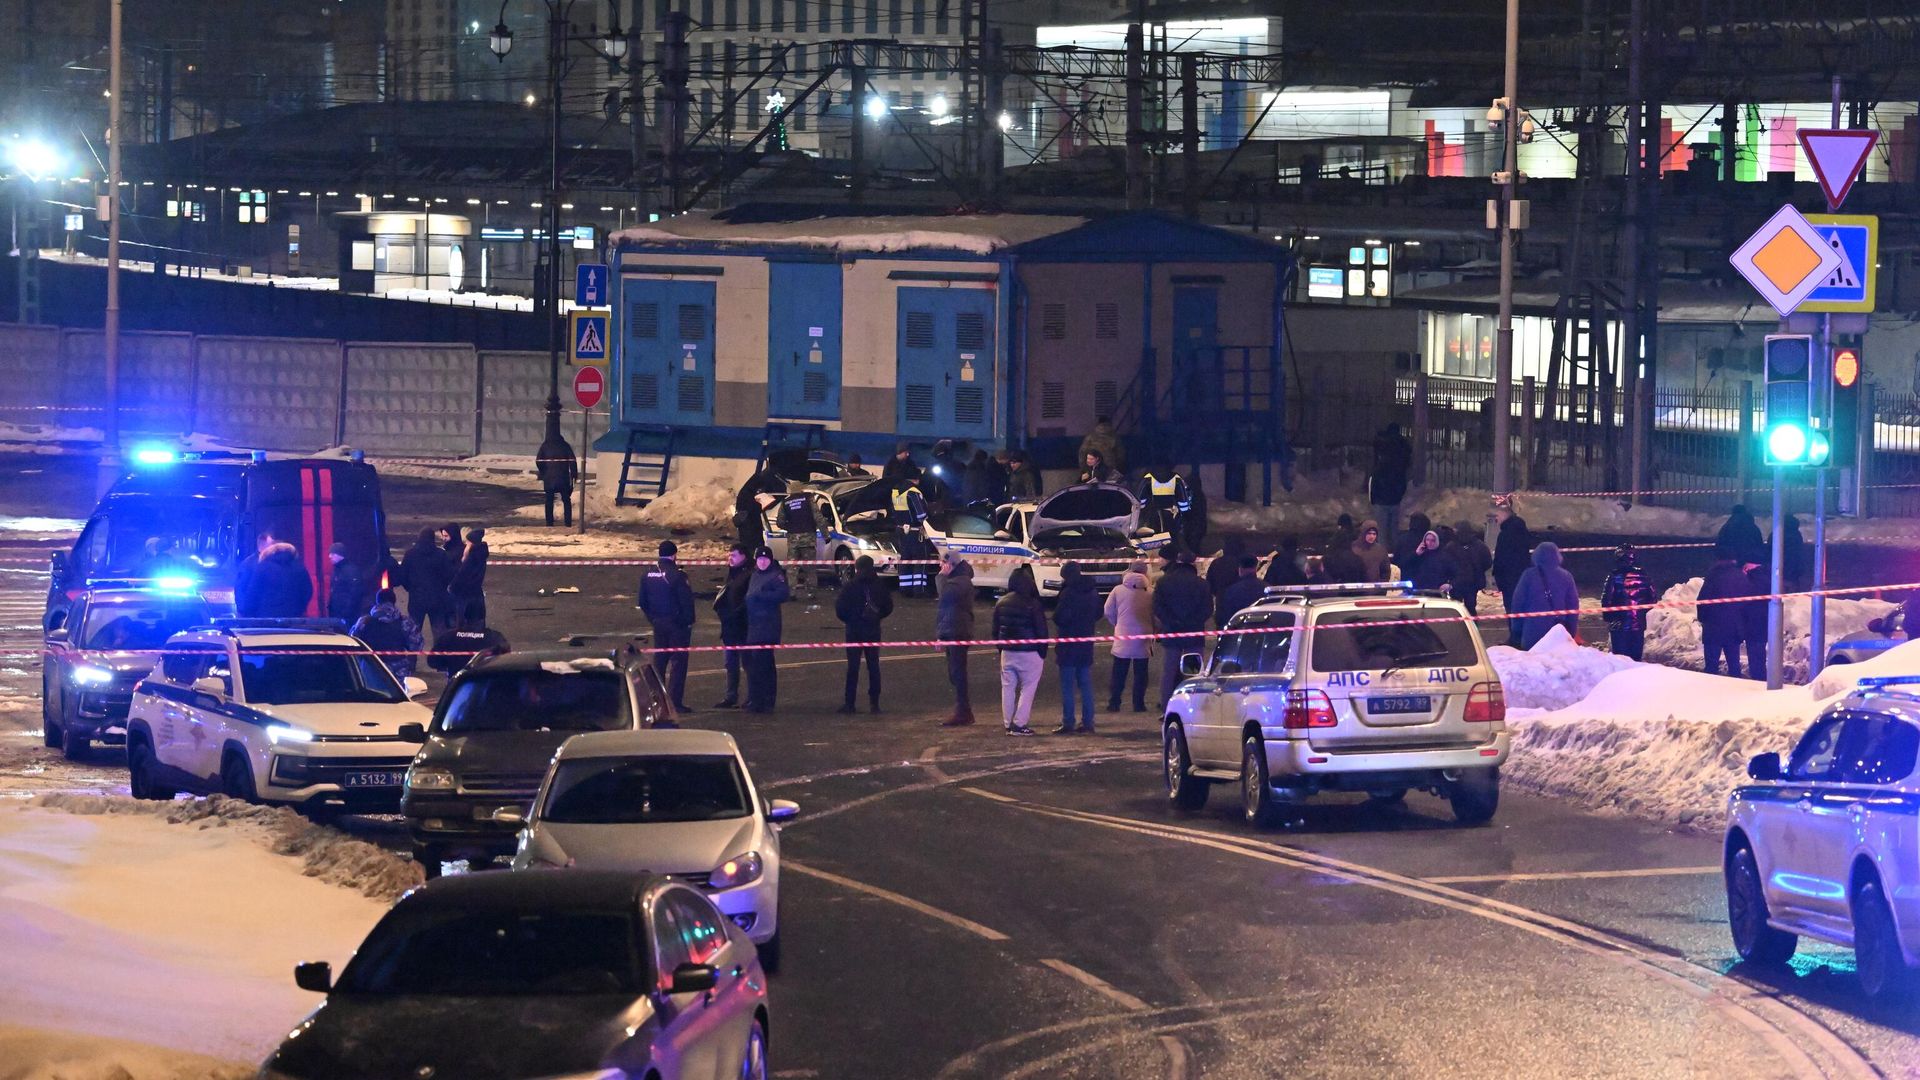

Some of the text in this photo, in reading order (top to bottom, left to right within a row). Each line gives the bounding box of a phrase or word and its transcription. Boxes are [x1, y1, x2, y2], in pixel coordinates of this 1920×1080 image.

[966, 545, 1005, 554] ПОЛИЦИЯ
[1327, 671, 1370, 687] ДПС
[1428, 667, 1469, 683] ДПС
[1383, 699, 1410, 710] 5792
[361, 774, 386, 785] 5132
